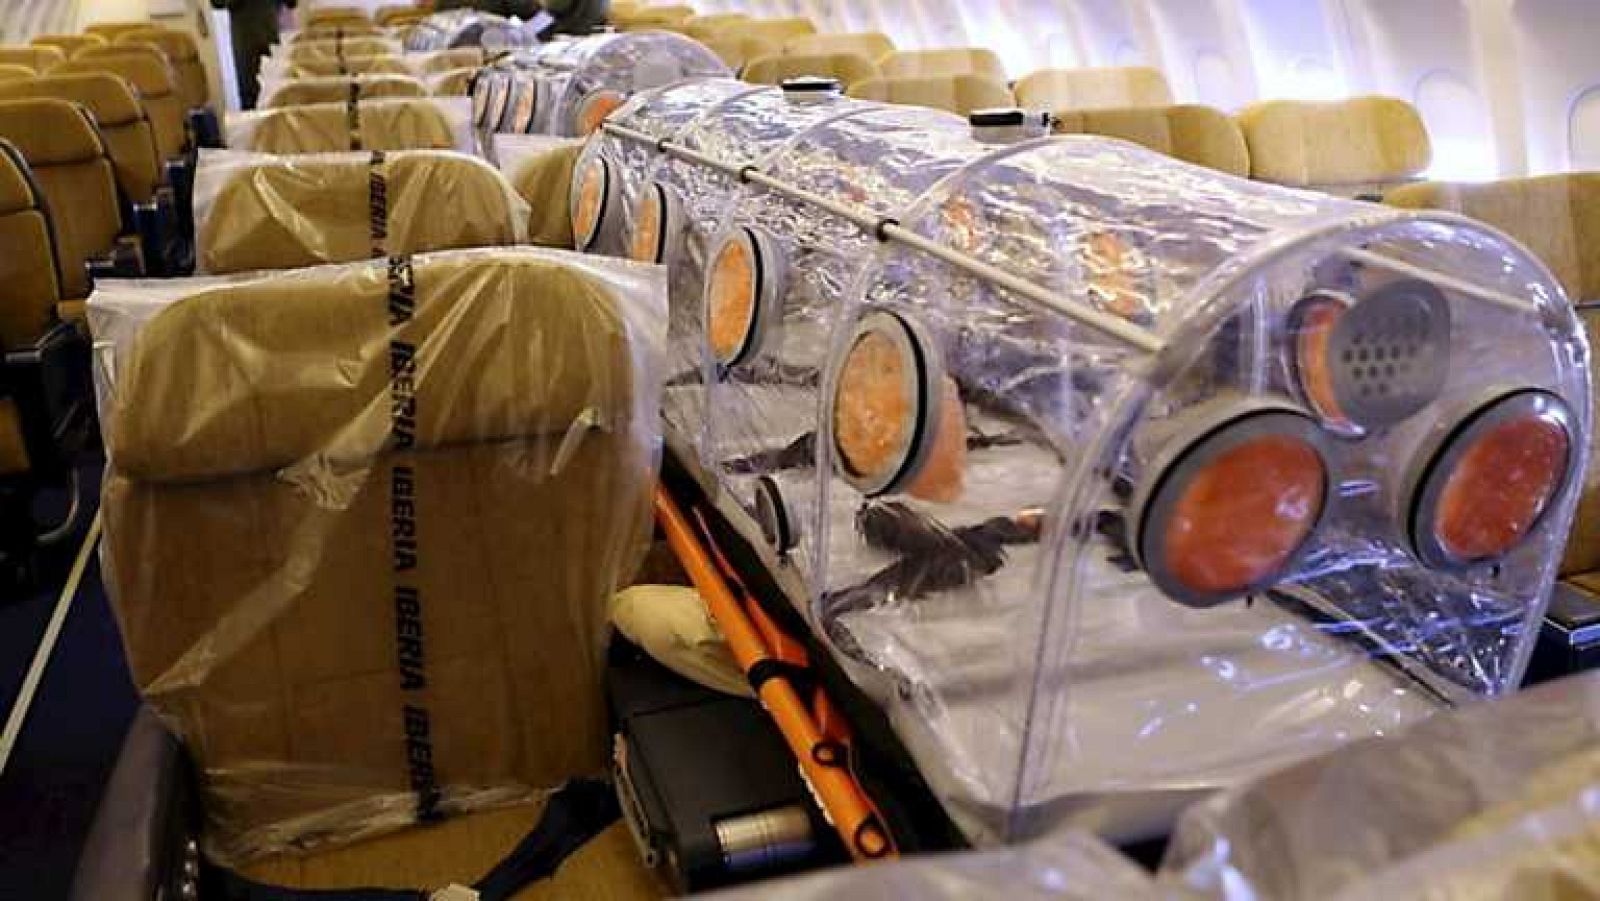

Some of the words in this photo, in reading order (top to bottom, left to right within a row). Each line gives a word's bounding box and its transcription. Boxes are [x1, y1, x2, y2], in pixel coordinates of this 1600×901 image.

[369, 172, 387, 239] IBERIA
[390, 340, 416, 449] IBERIA
[392, 465, 418, 572] IBERIA
[396, 585, 424, 691] IBERIA
